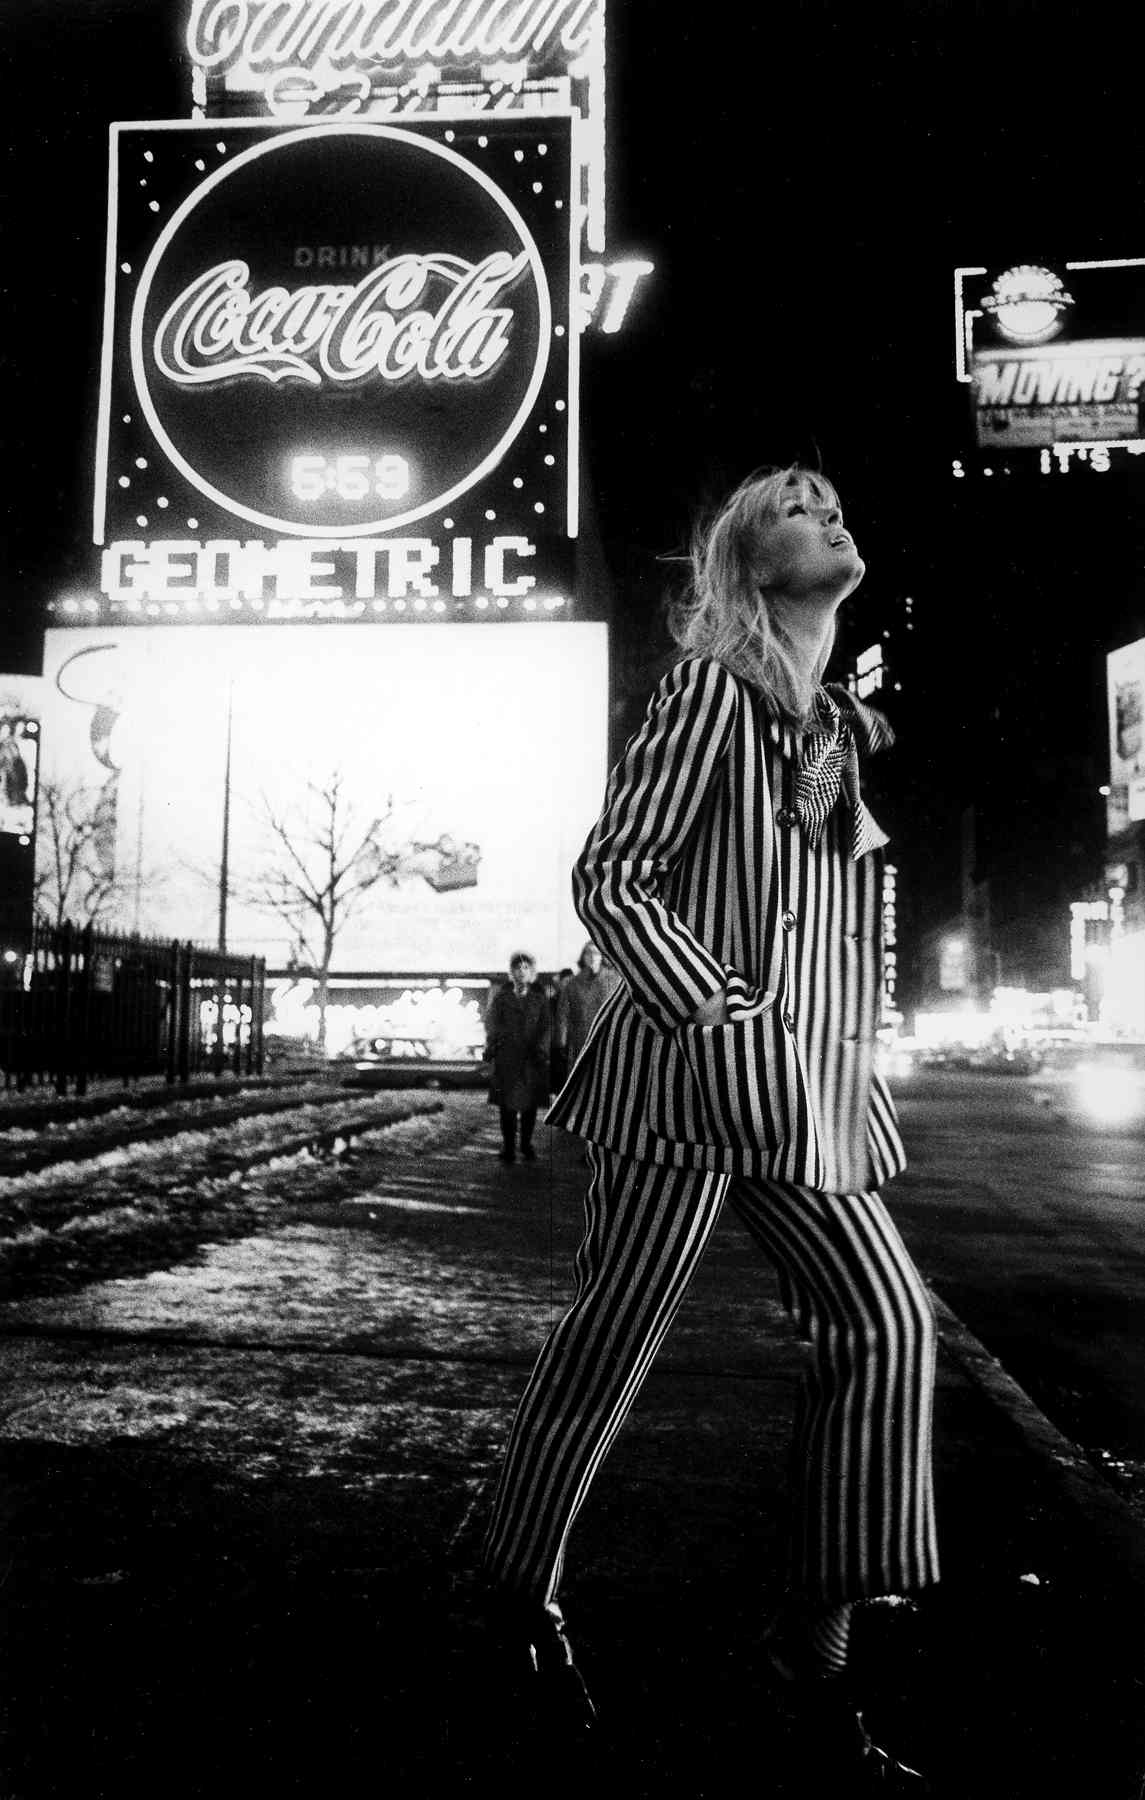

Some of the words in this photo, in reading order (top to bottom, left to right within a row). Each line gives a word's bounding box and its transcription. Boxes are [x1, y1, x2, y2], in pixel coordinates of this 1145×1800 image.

[294, 244, 393, 269] DRINK
[153, 252, 533, 385] Coca-Cola
[101, 537, 536, 602] GEOMETRIC
